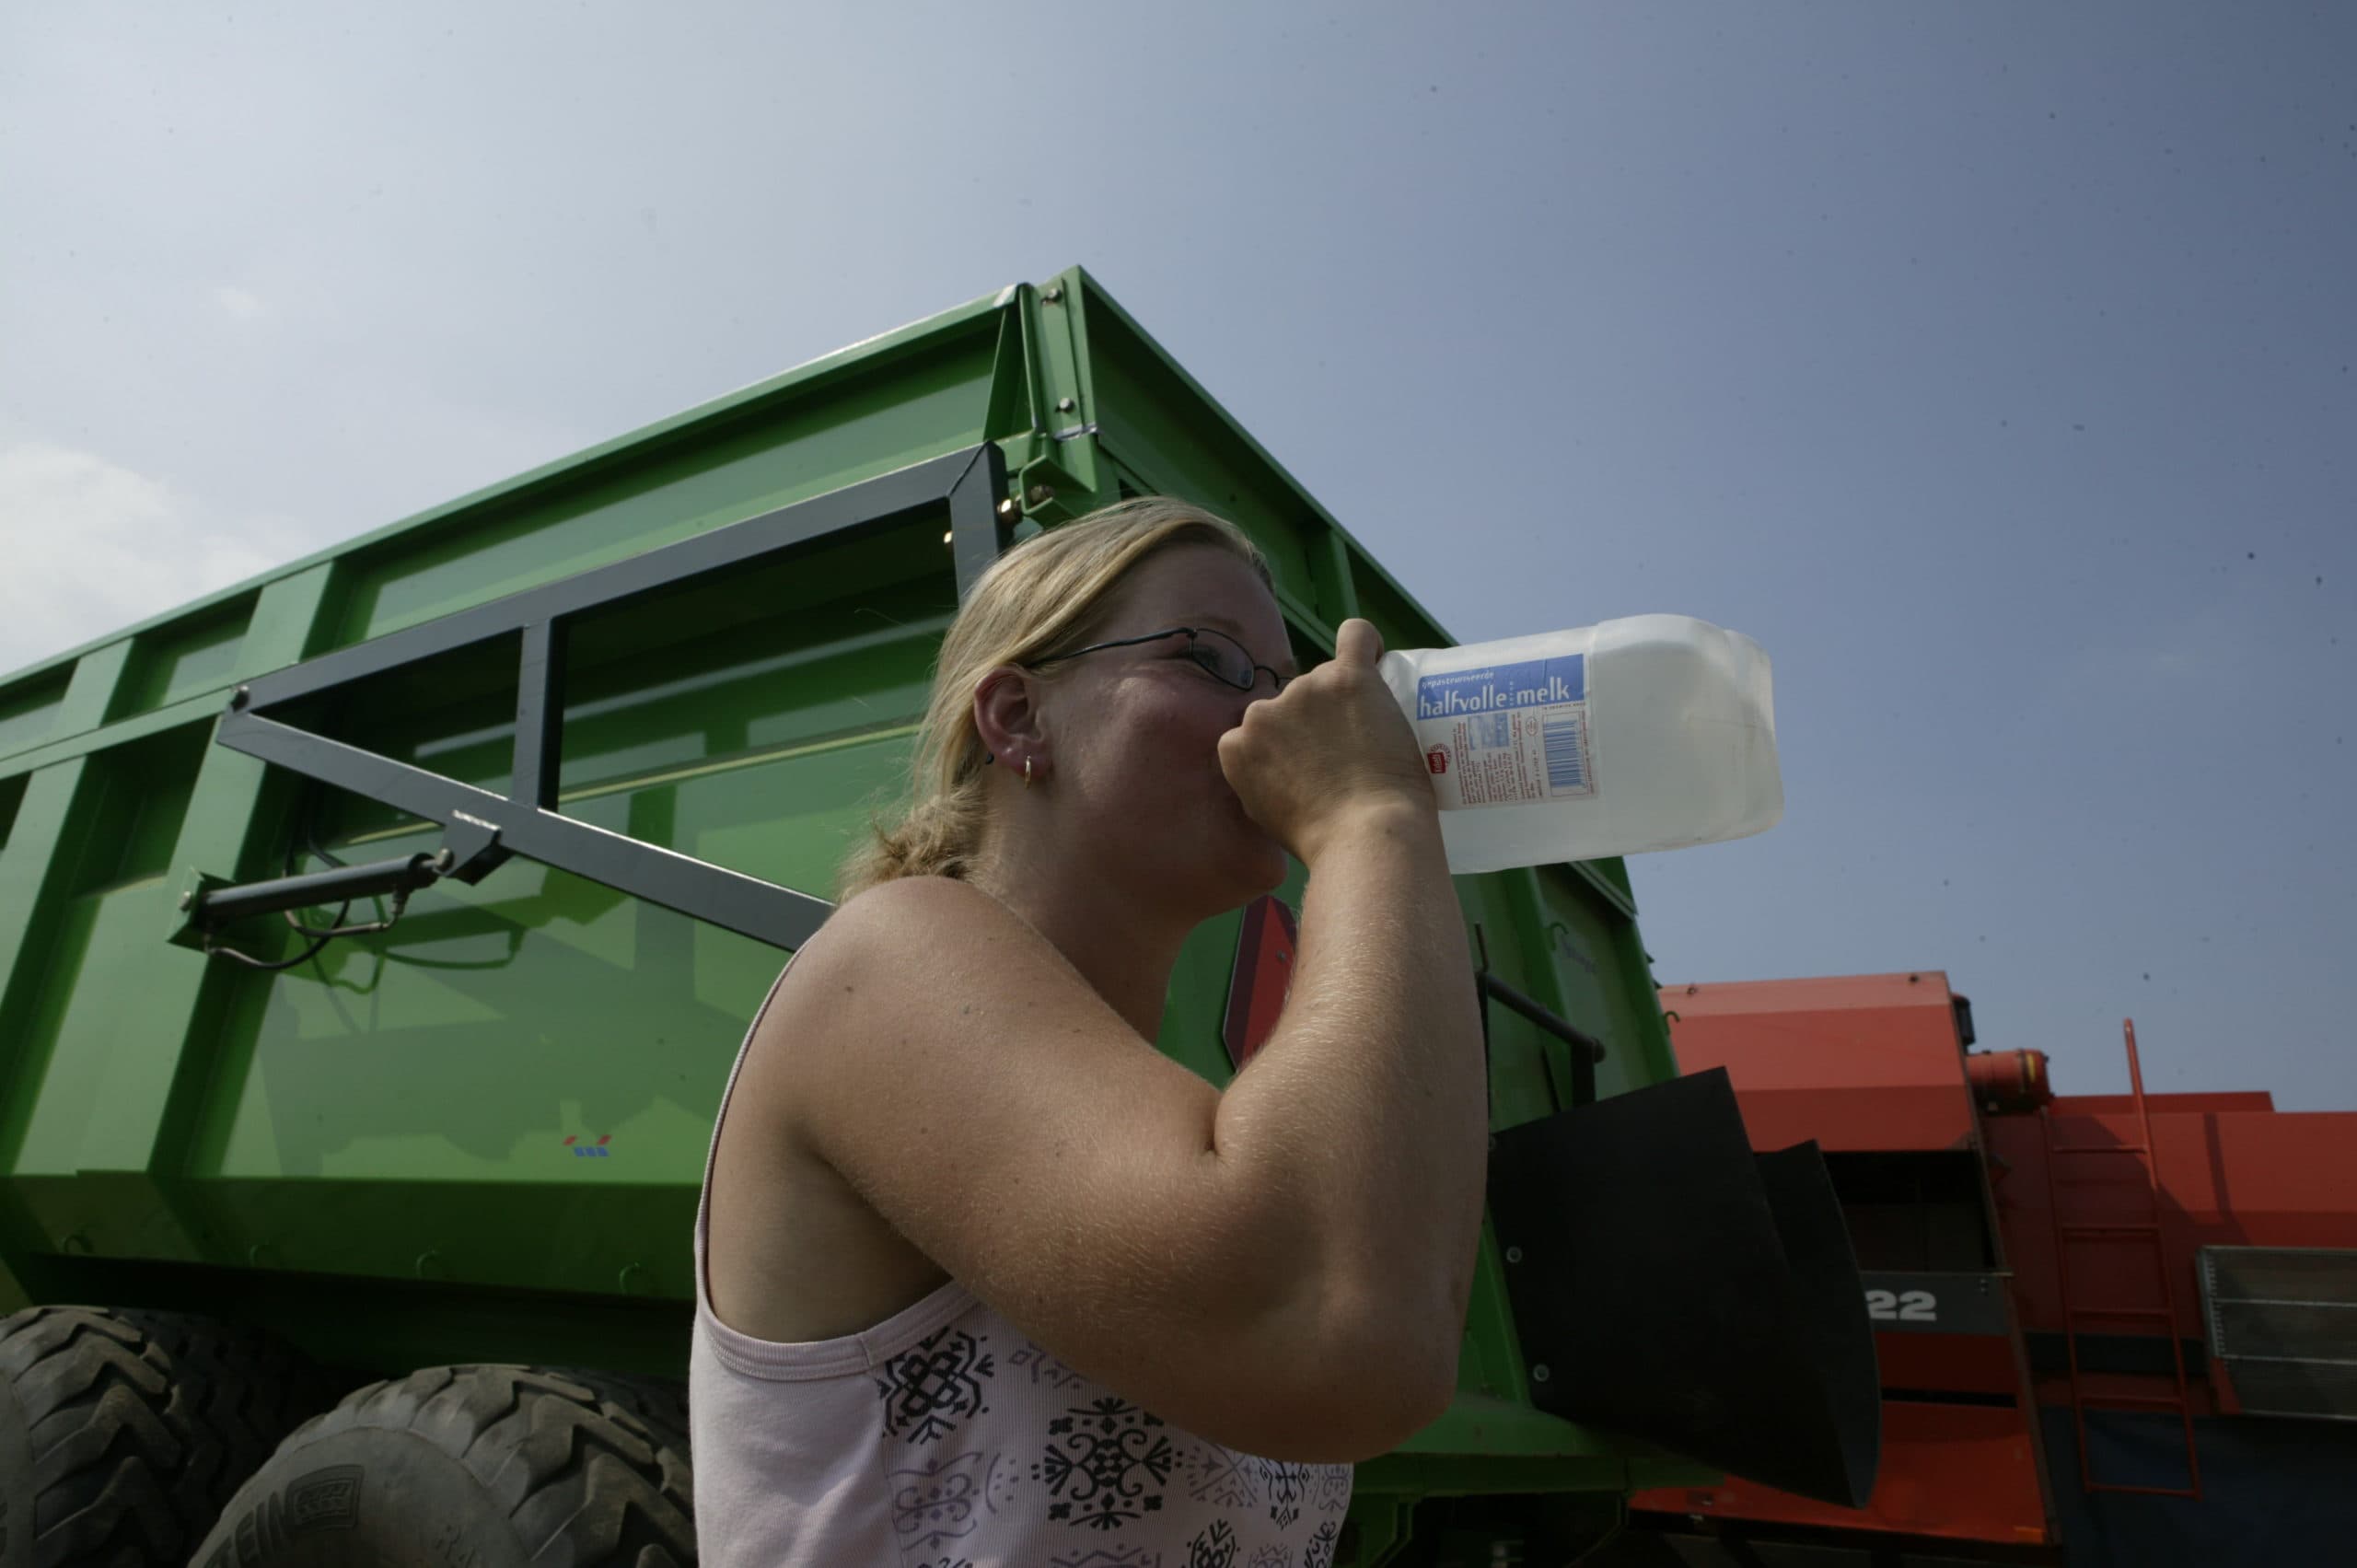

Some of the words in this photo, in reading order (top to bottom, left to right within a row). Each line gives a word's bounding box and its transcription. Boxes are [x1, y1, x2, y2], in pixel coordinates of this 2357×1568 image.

[1420, 684, 1507, 718] halfvolle
[1516, 676, 1571, 705] melk
[1864, 1289, 1937, 1321] 22
